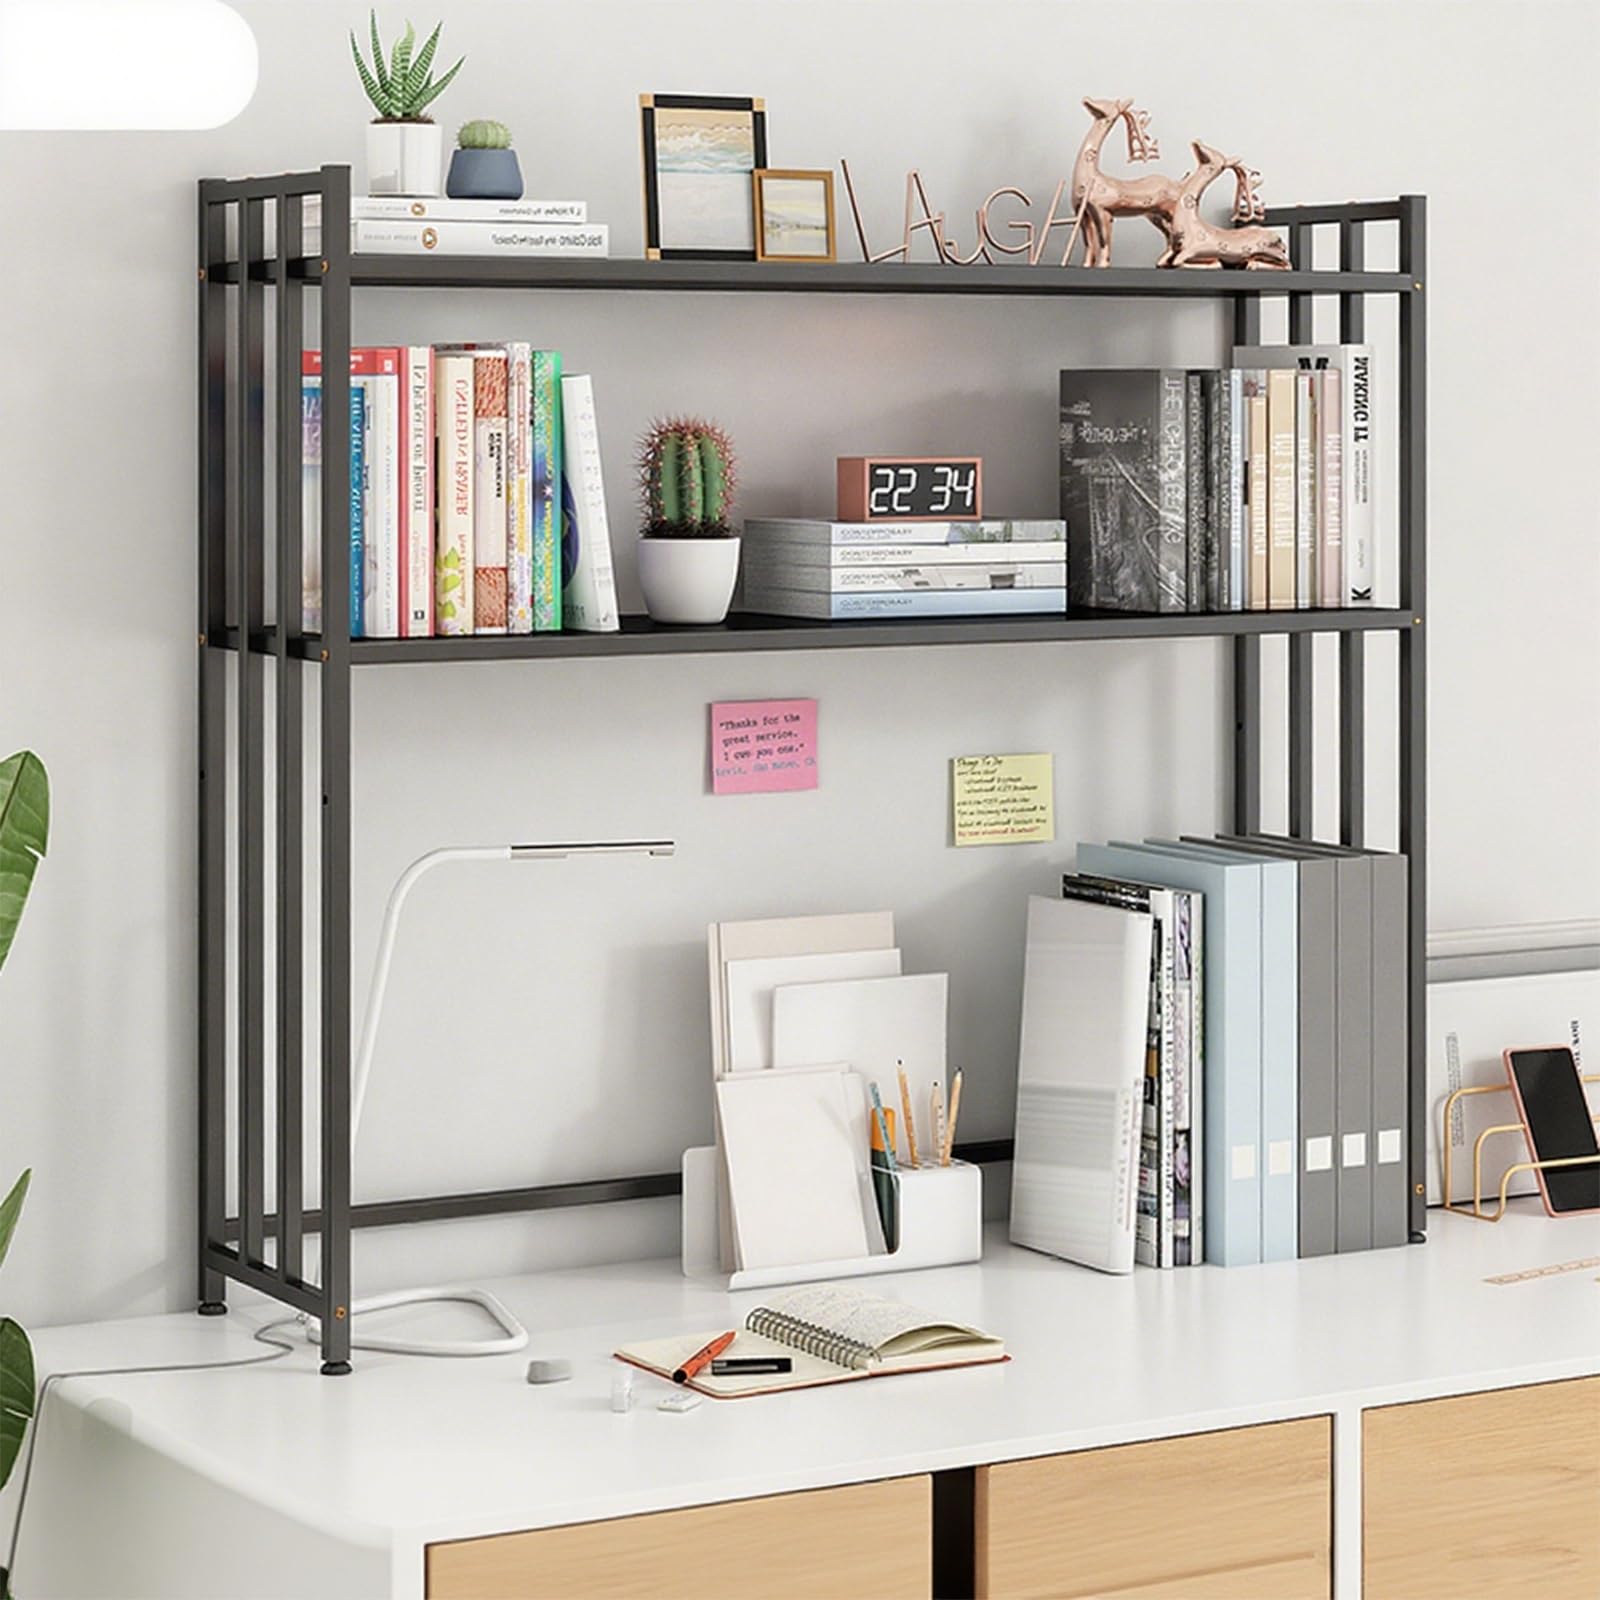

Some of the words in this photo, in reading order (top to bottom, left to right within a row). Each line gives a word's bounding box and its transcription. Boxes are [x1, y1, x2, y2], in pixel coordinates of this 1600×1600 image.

[840, 157, 1095, 266] LAUGH
[870, 467, 917, 512] 22
[929, 466, 975, 511] 34
[719, 716, 757, 730] "Thanks
[763, 715, 779, 725] for
[784, 713, 800, 722] the
[722, 734, 750, 747] great
[733, 750, 752, 760] owe
[756, 748, 773, 759] you
